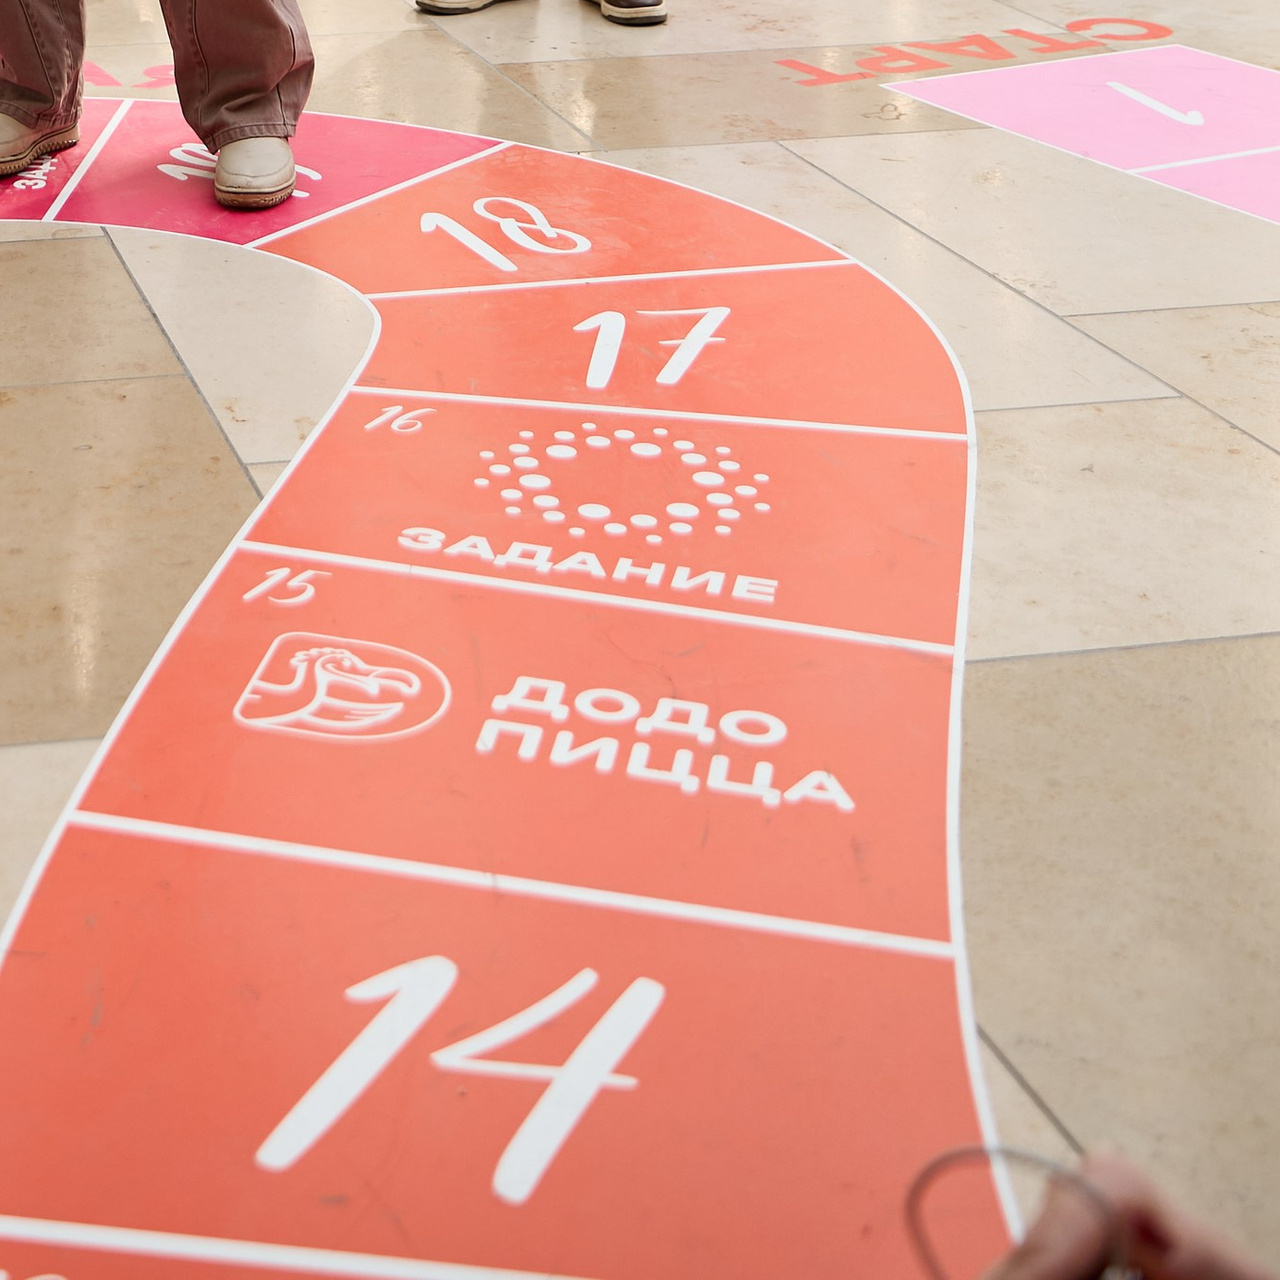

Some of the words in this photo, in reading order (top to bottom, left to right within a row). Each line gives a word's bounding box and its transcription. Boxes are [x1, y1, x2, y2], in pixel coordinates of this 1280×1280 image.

[773, 17, 1174, 87] СТАРТ
[1105, 80, 1204, 127] 1
[419, 196, 592, 272] 18
[572, 306, 731, 389] 17
[363, 404, 440, 435] 16
[241, 567, 332, 608] 15
[397, 527, 780, 604] ЗАДАНИЕ
[490, 674, 788, 747] ДОДО
[475, 718, 856, 813] ПИЦЦА
[254, 953, 667, 1206] 14
